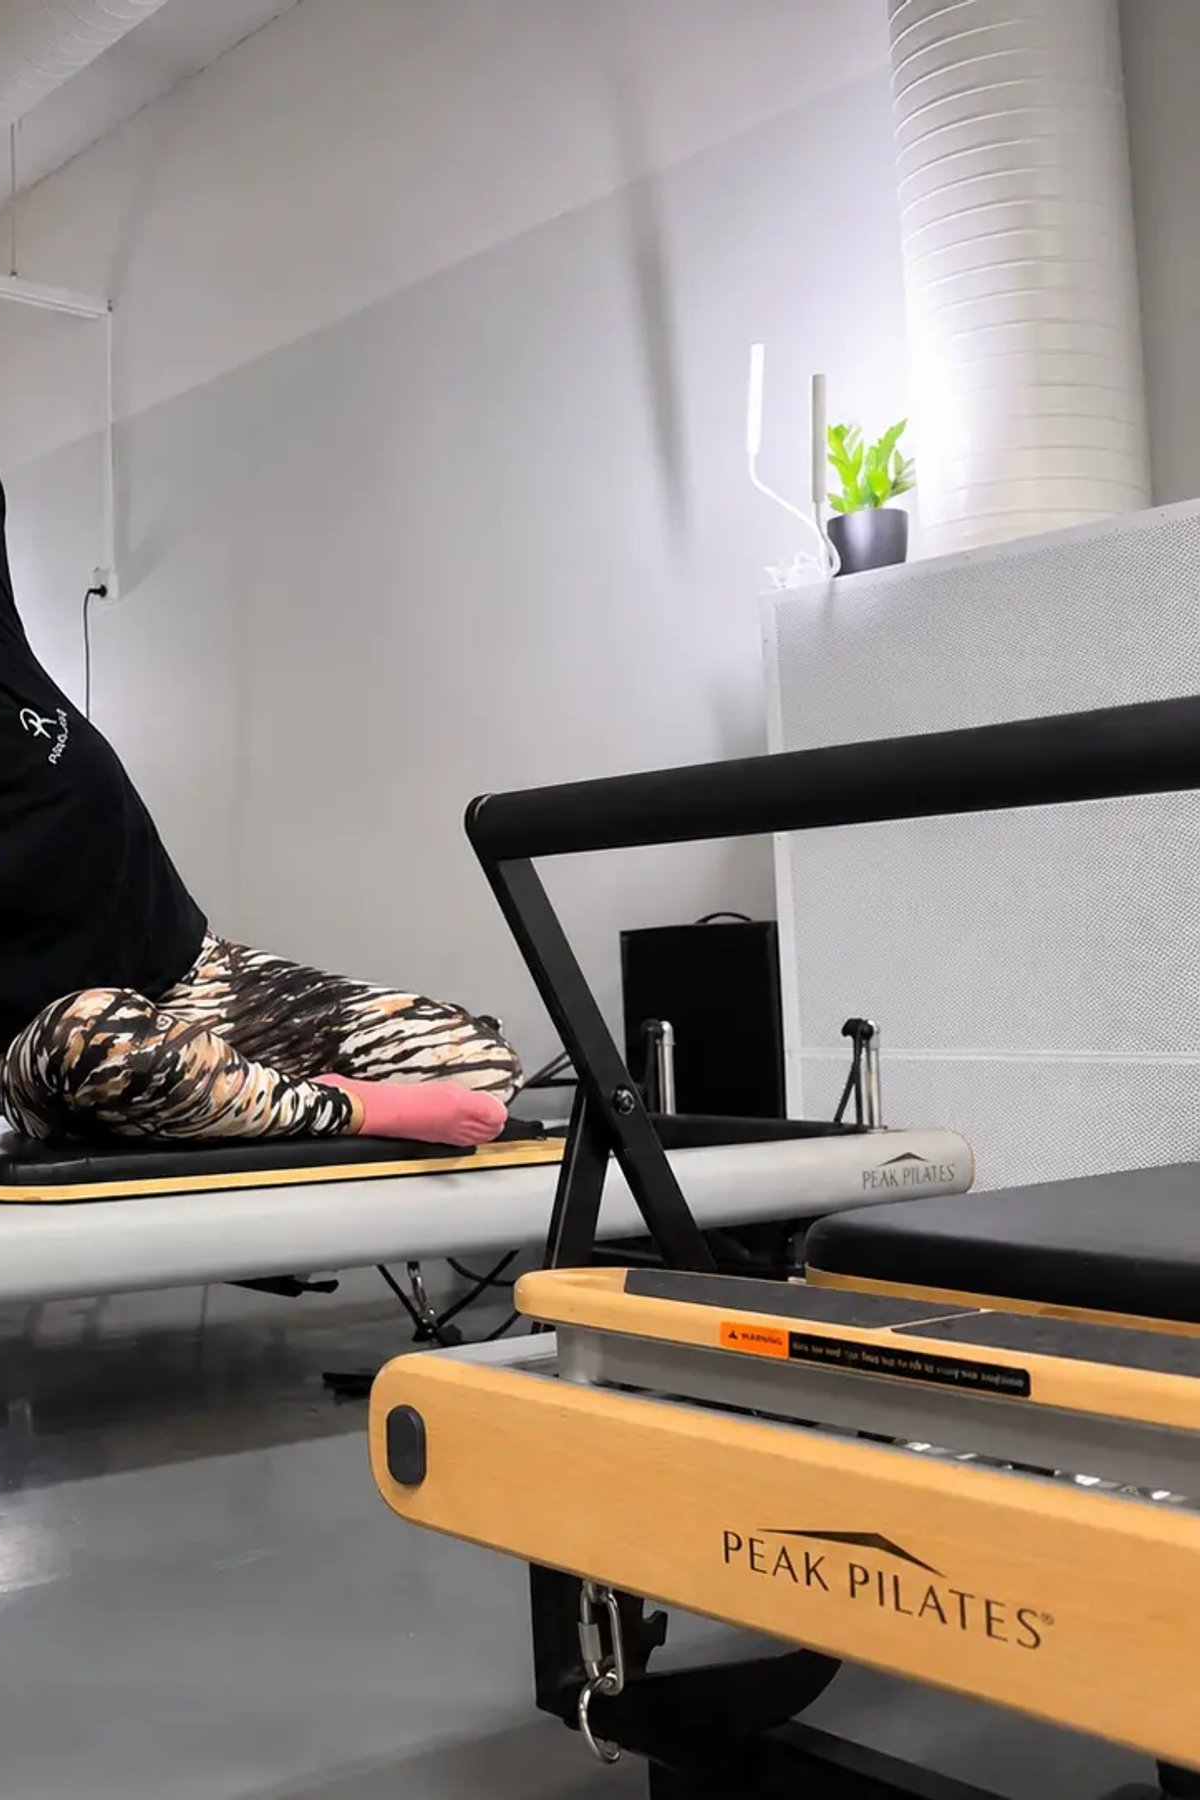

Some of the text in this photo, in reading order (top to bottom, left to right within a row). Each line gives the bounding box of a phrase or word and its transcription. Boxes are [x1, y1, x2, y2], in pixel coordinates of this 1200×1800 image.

[862, 1163, 955, 1190] PEAK PILATES
[723, 1530, 829, 1592] PEAK
